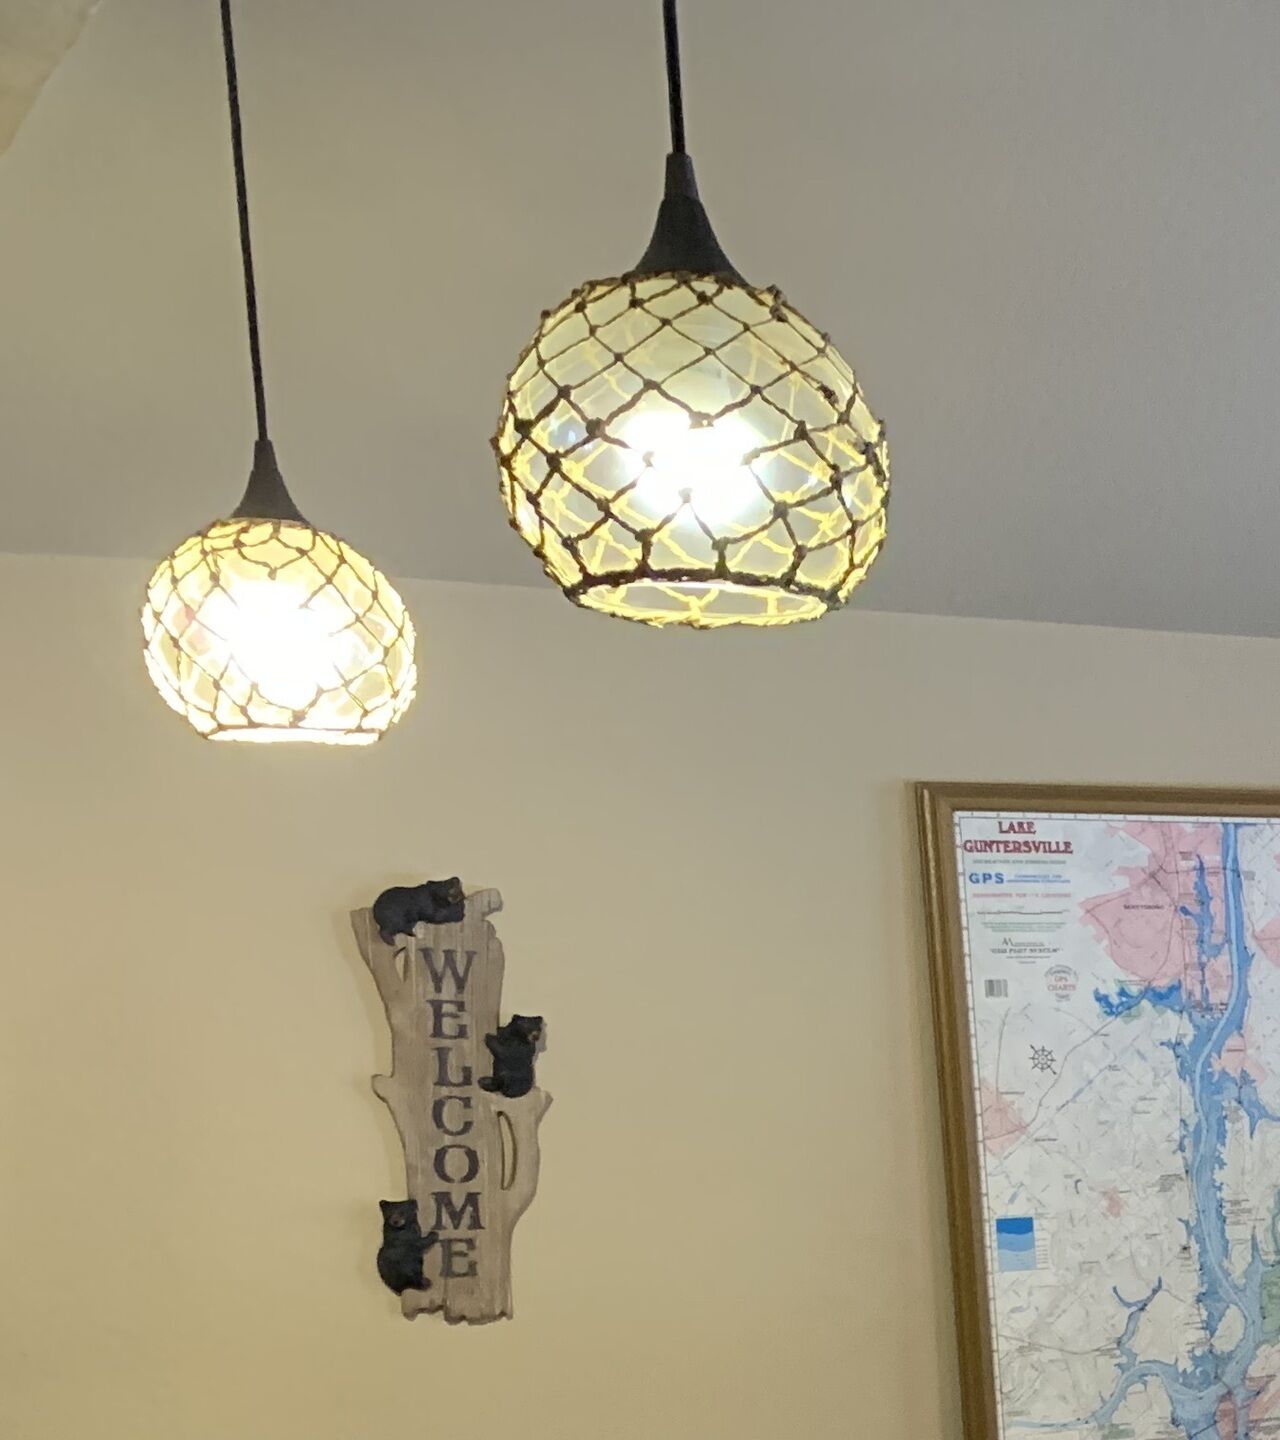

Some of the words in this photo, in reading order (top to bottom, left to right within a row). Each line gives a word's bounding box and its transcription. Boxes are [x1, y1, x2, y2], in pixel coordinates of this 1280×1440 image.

[998, 821, 1036, 834] LAKE
[963, 839, 1073, 854] GUNTERSVILLE
[968, 872, 1005, 885] GPS
[418, 947, 485, 1279] WELCOME
